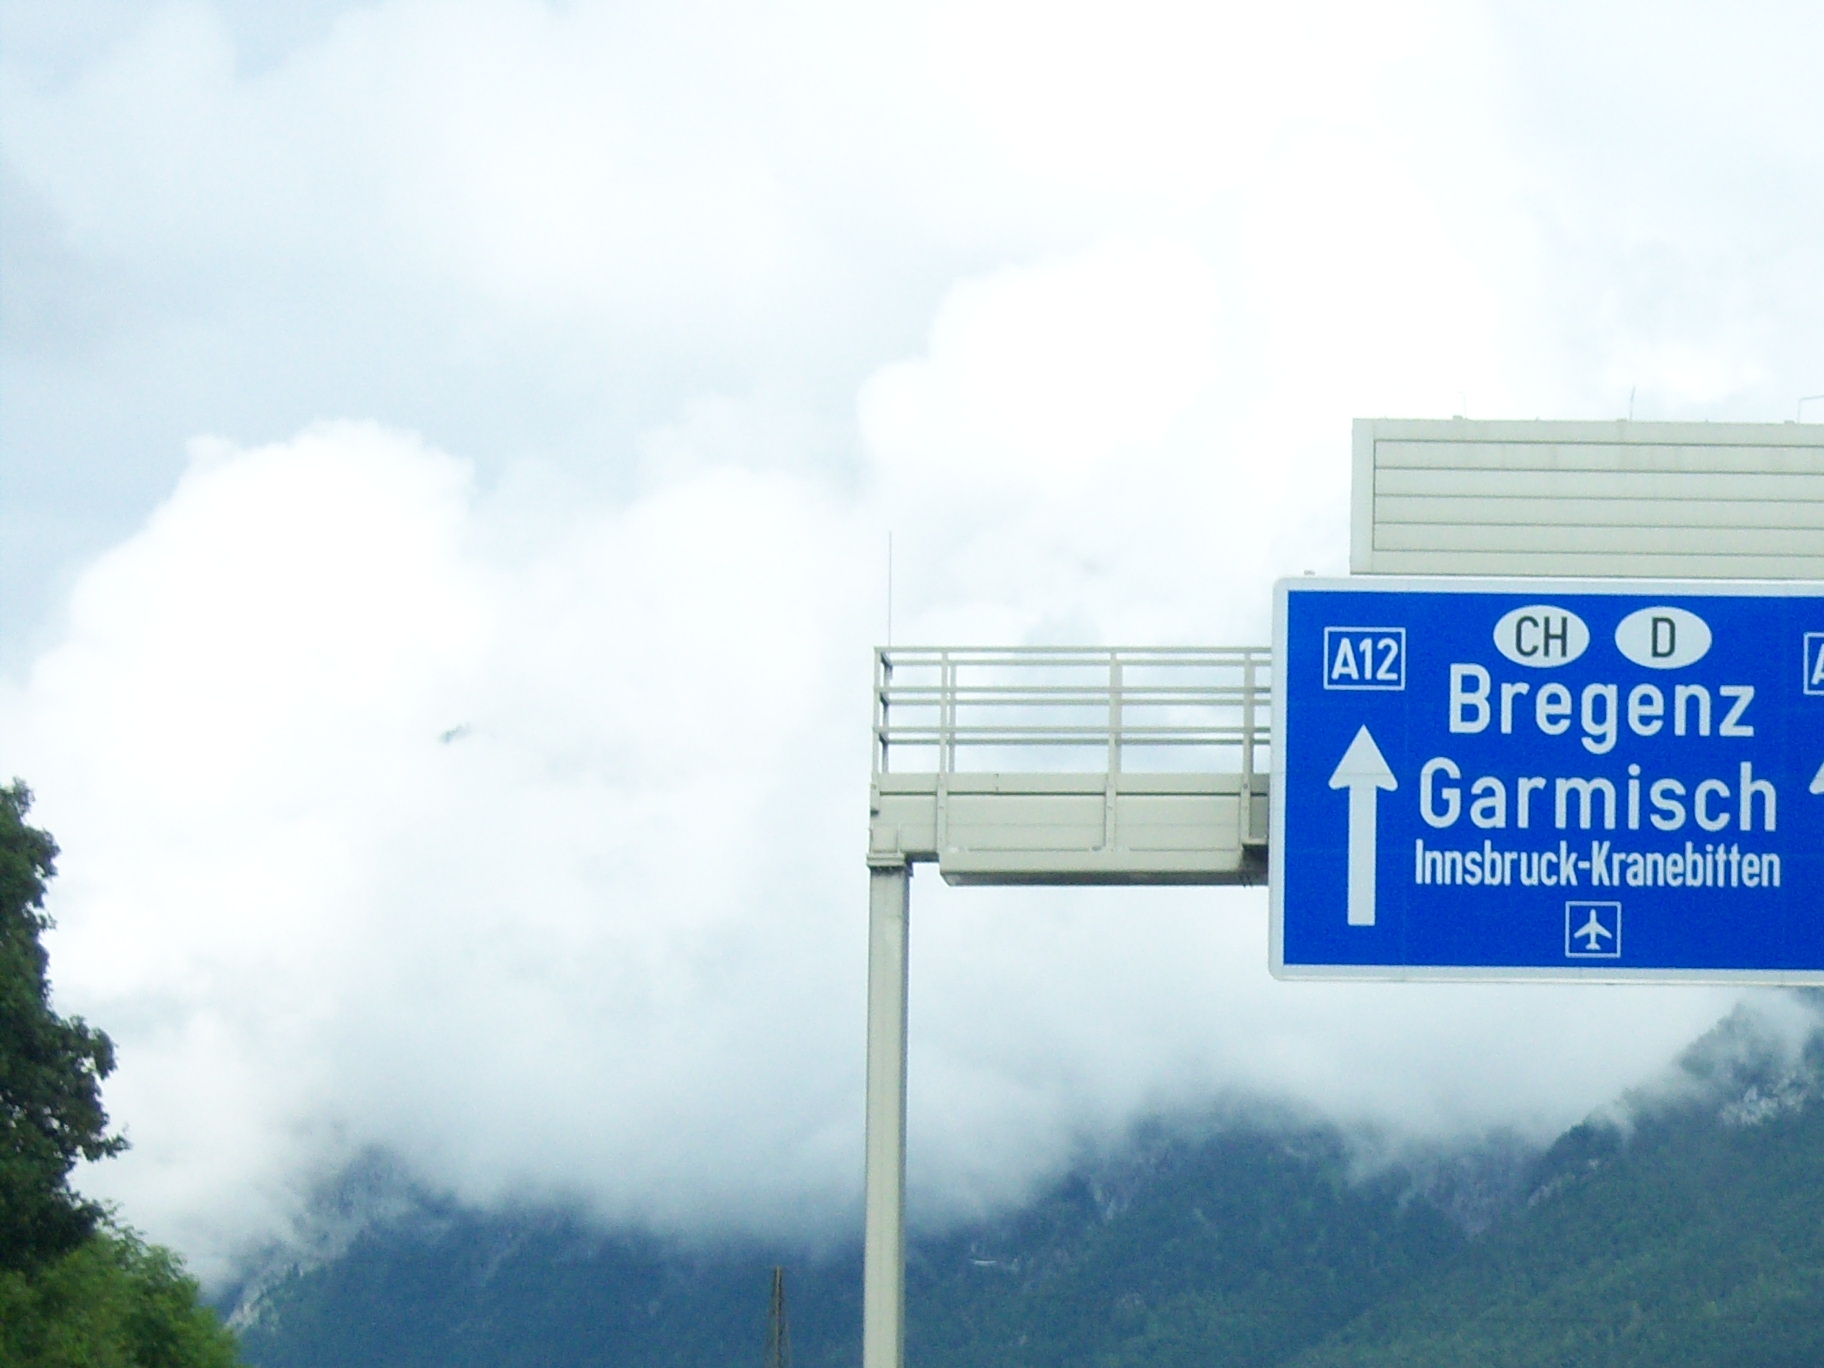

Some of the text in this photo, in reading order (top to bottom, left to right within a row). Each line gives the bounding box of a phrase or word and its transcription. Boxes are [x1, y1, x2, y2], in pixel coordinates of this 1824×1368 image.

[1331, 637, 1399, 681] A12
[1515, 615, 1568, 658] CH
[1651, 616, 1676, 659] D
[1449, 662, 1755, 755] Bregenz
[1419, 756, 1777, 832] Garmisch
[1415, 838, 1781, 888] Innsbruck-Kranebitten
